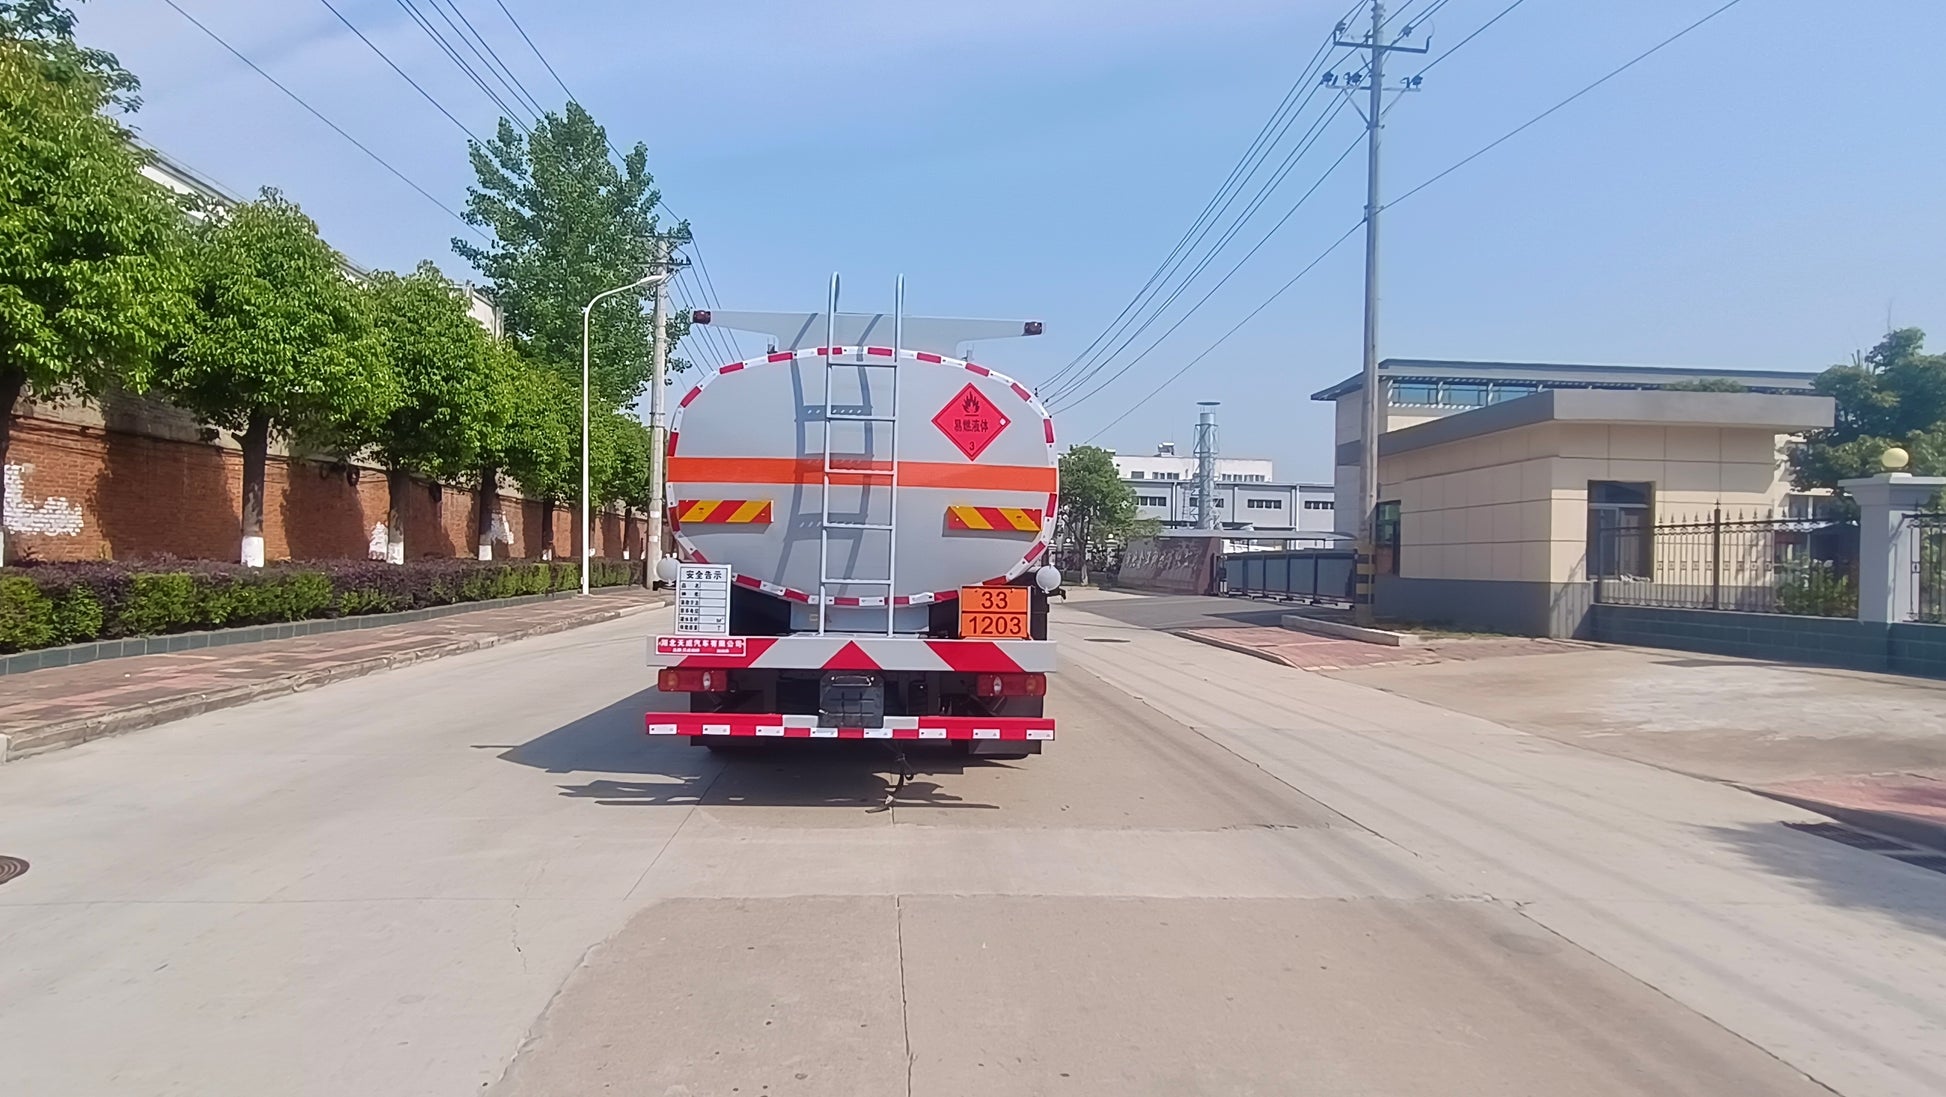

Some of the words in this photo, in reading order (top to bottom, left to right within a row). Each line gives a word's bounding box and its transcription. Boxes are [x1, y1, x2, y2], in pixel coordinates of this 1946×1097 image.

[954, 419, 989, 432] 易燃液体
[969, 441, 975, 451] 3
[686, 570, 722, 580] 安全告示
[981, 591, 1008, 610] 33
[969, 616, 1022, 635] 1203
